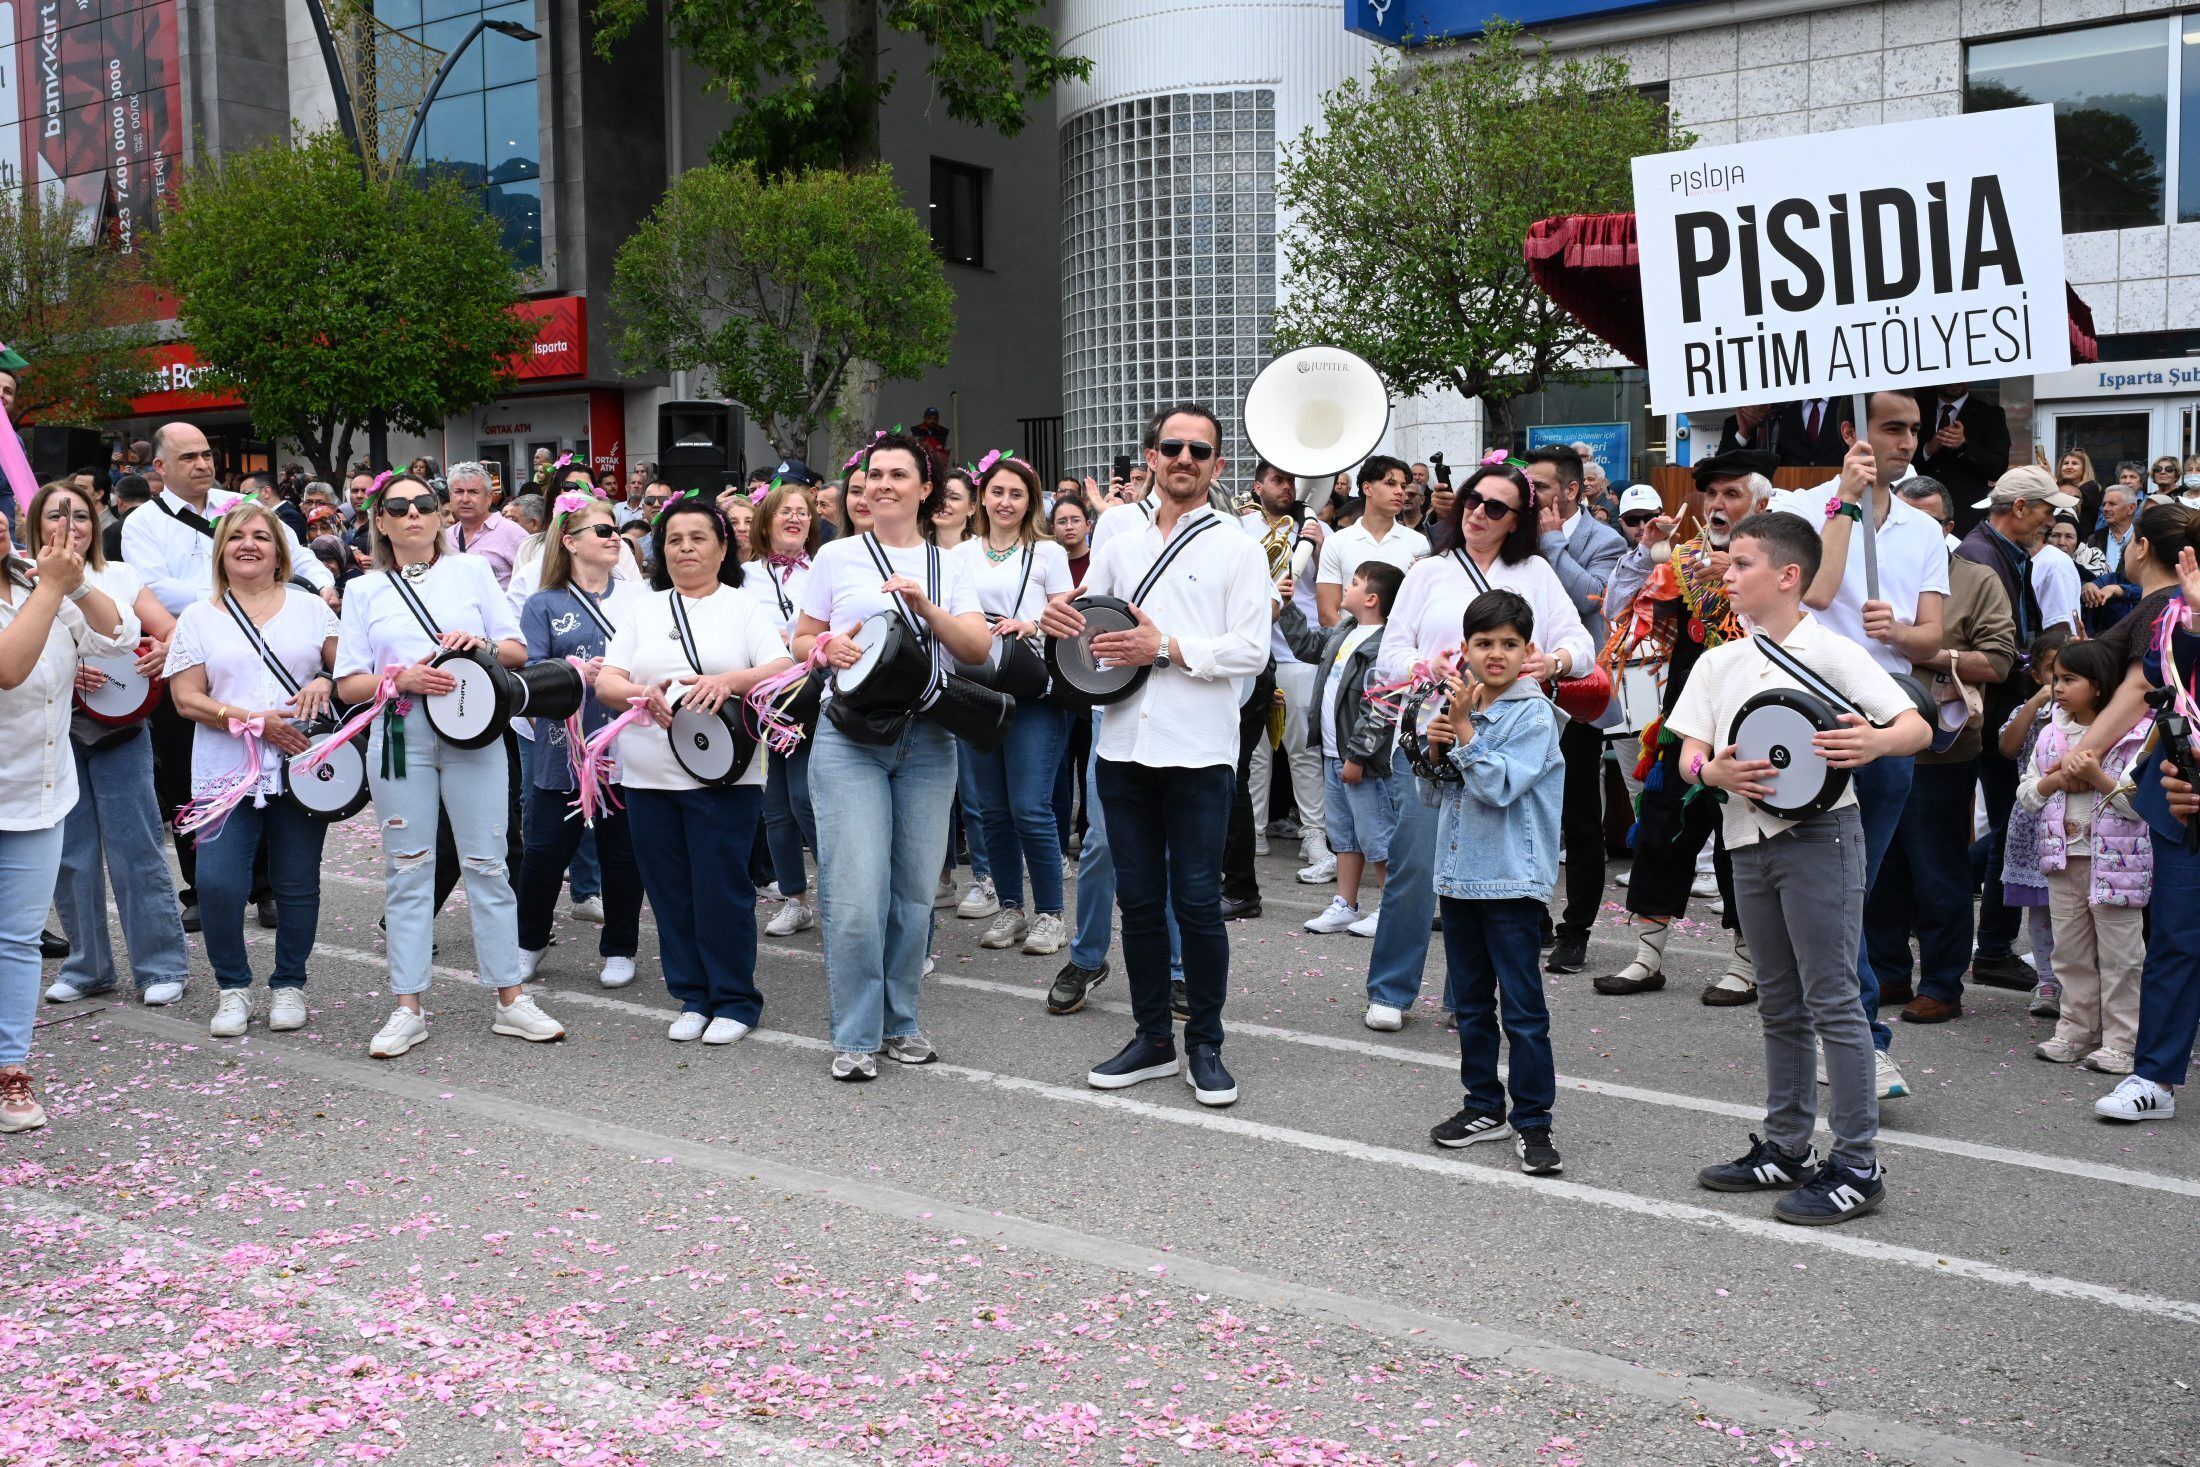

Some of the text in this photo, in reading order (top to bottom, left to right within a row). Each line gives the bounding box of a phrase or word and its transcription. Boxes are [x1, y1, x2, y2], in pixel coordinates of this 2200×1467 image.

[113, 106, 126, 150] 0000
[116, 156, 129, 202] 7400
[534, 341, 568, 355] Isparta
[1684, 290, 2032, 397] RİTİM ATÖLYESİ
[1310, 361, 1349, 372] JUPITER
[2098, 371, 2163, 390] Isparta
[485, 423, 532, 435] ORTAK ATM
[595, 456, 619, 465] ORTAK
[600, 464, 615, 472] ATM
